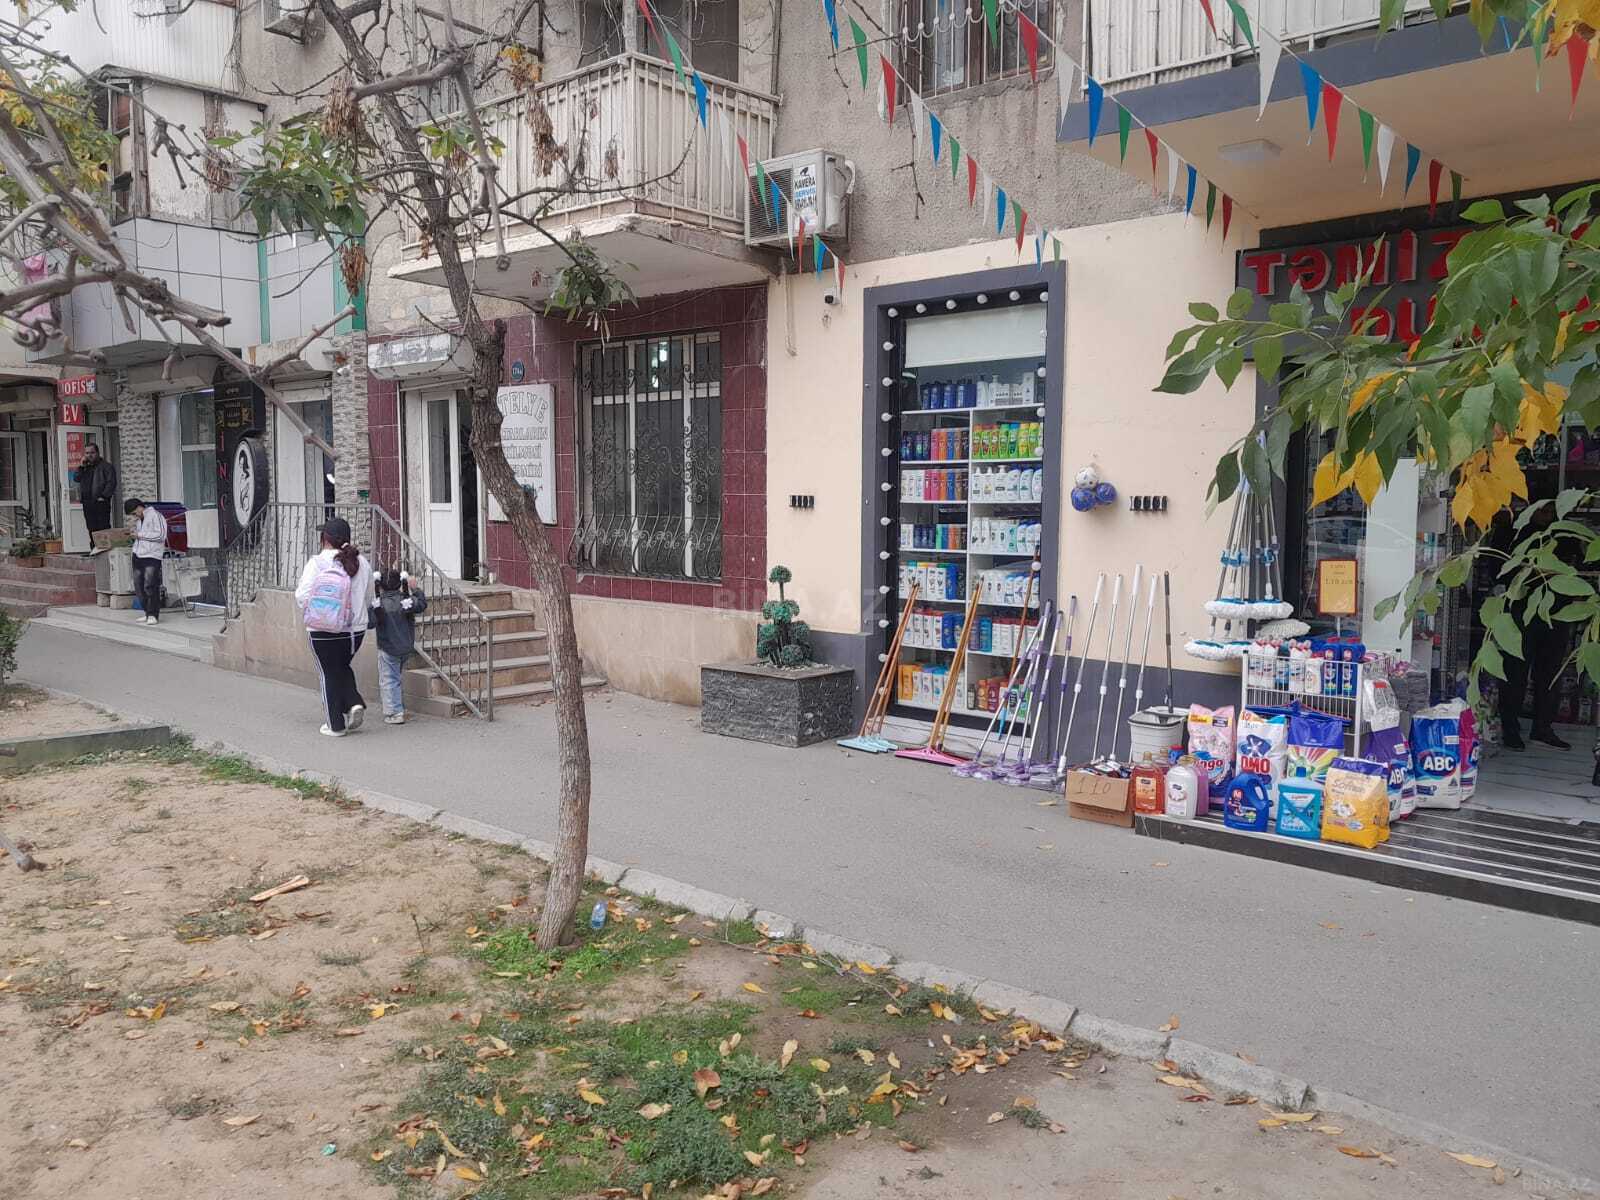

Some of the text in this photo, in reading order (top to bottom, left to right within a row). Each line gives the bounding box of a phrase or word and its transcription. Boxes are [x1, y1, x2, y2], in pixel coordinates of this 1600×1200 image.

[63, 403, 79, 423] EV
[497, 391, 549, 424] TELYE
[1241, 756, 1272, 774] OMO
[1423, 756, 1455, 772] ABC
[1389, 766, 1408, 786] ABC
